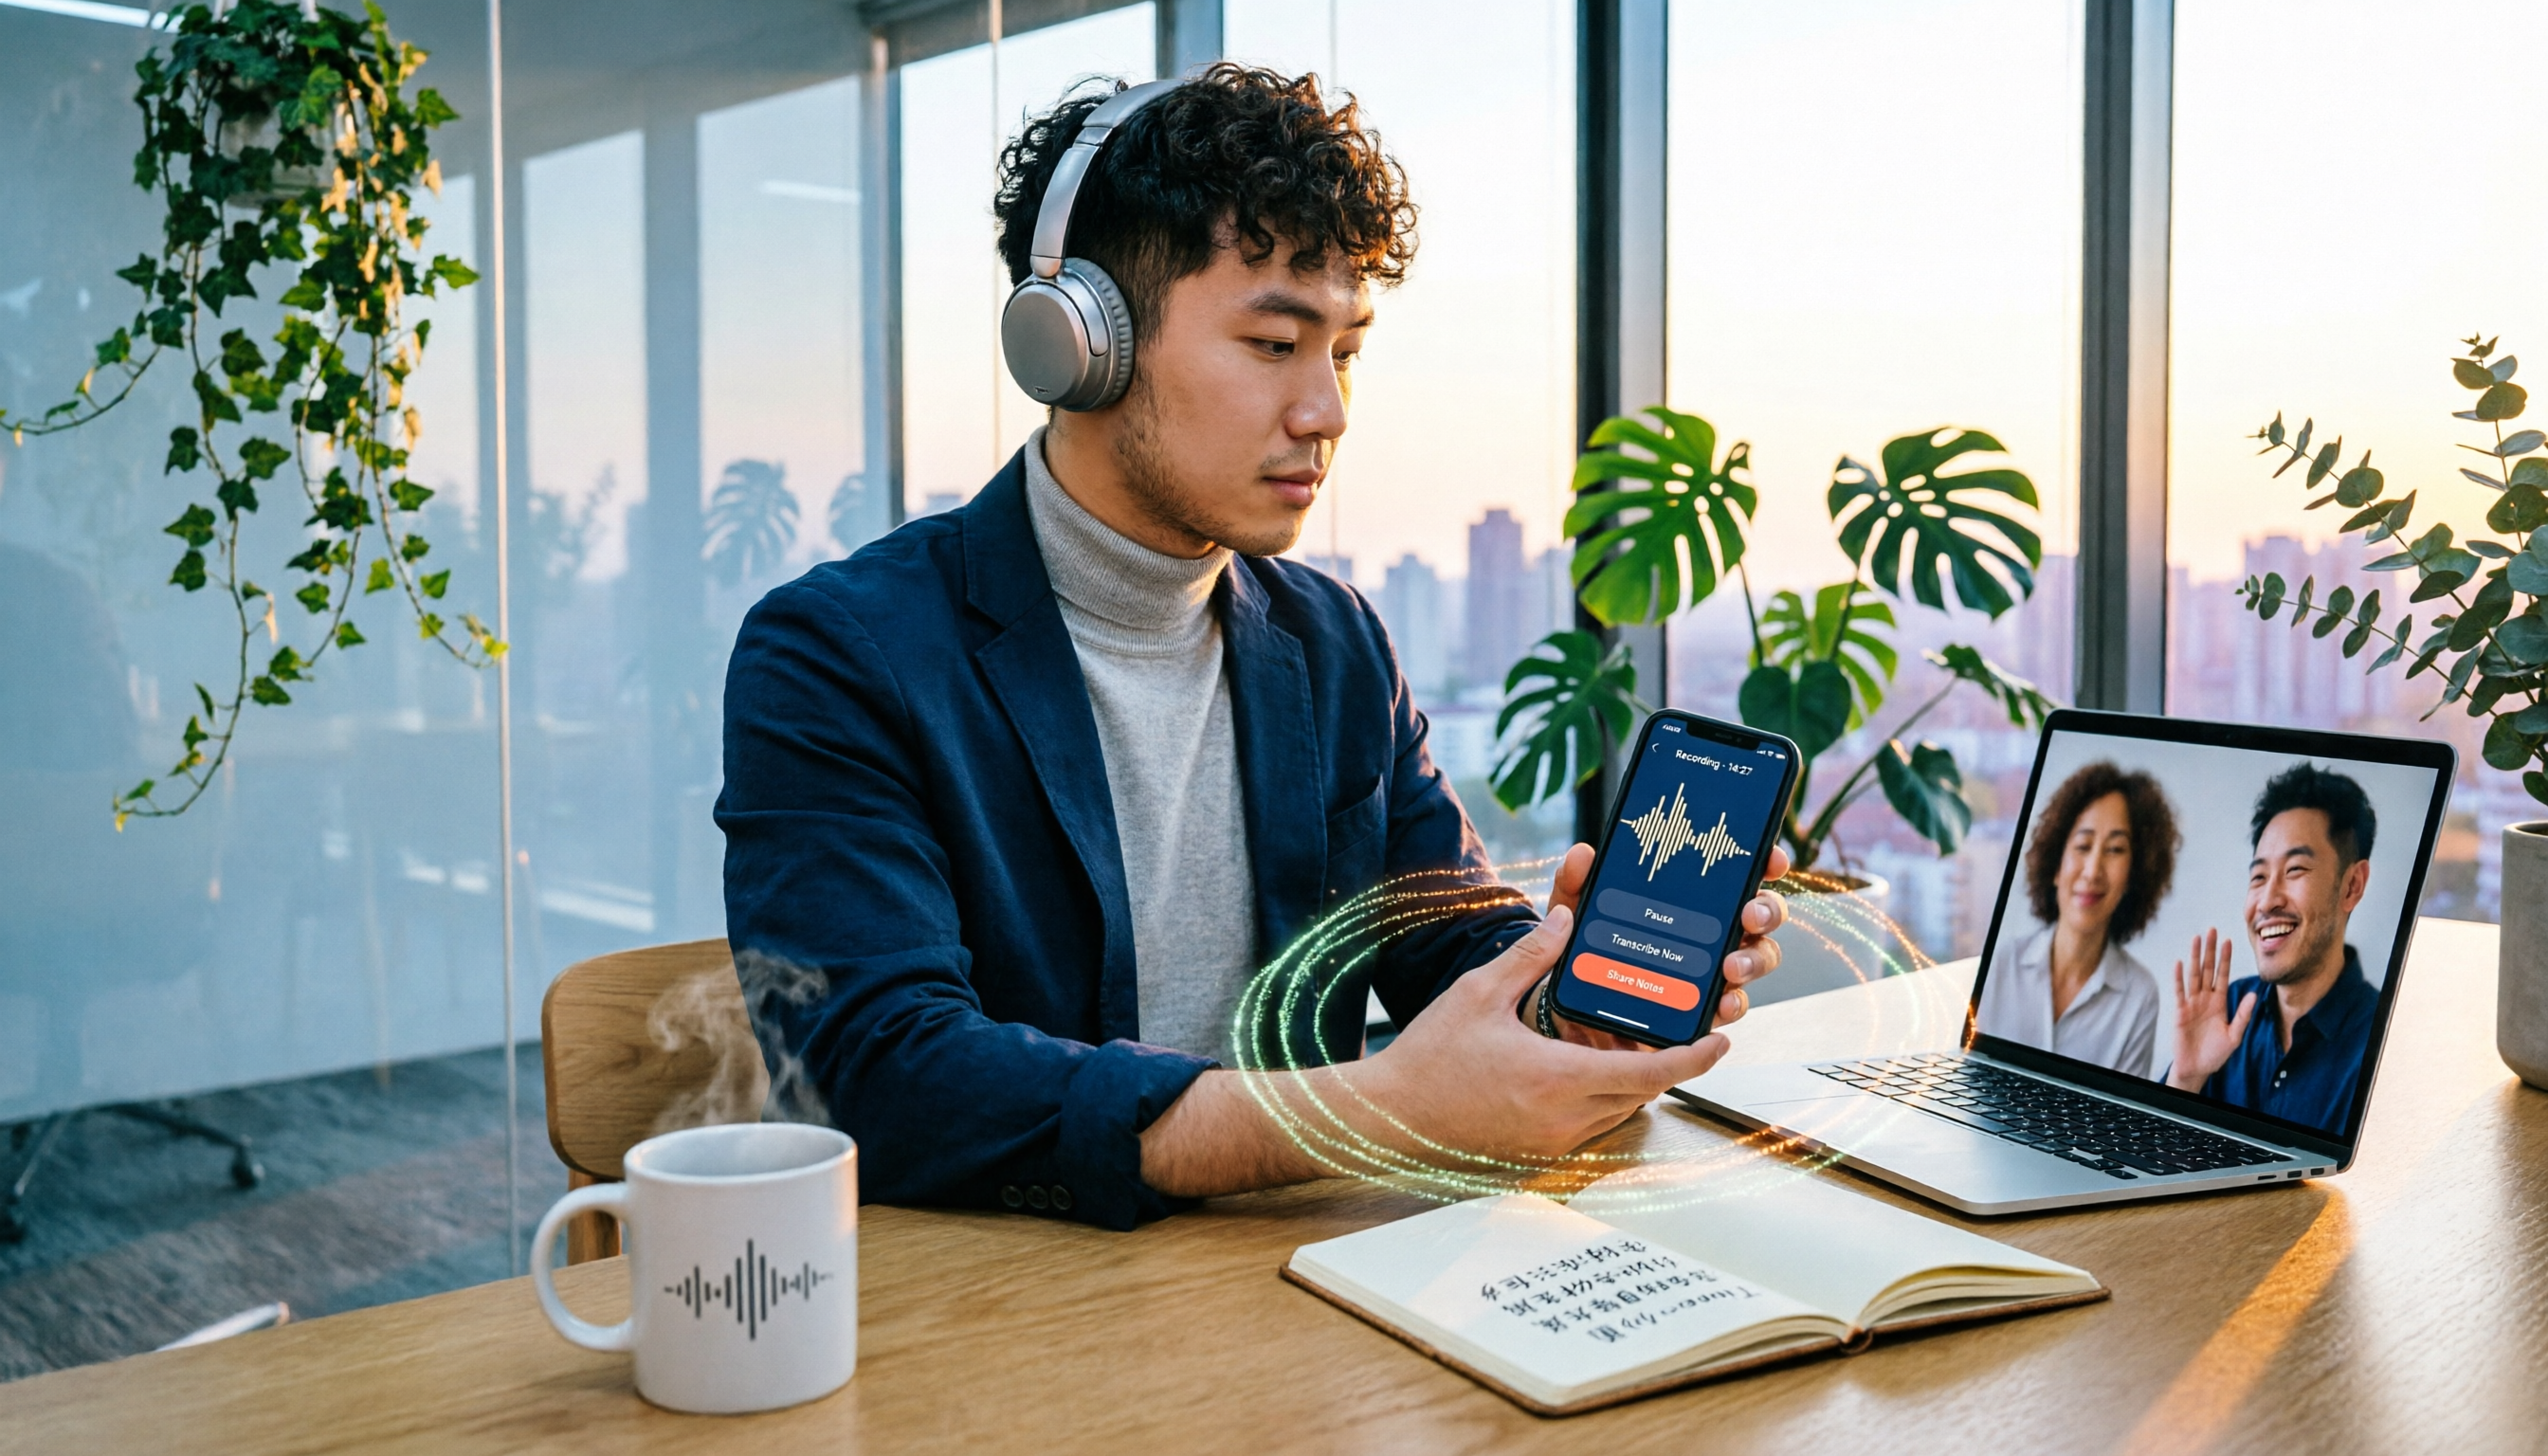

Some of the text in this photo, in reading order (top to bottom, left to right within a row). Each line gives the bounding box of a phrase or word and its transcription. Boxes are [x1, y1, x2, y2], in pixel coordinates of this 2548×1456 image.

[1675, 749, 1720, 771] Recording
[1645, 907, 1674, 925] Pause
[1611, 933, 1684, 962] Transcribe Now
[1607, 969, 1665, 994] Share Notes
